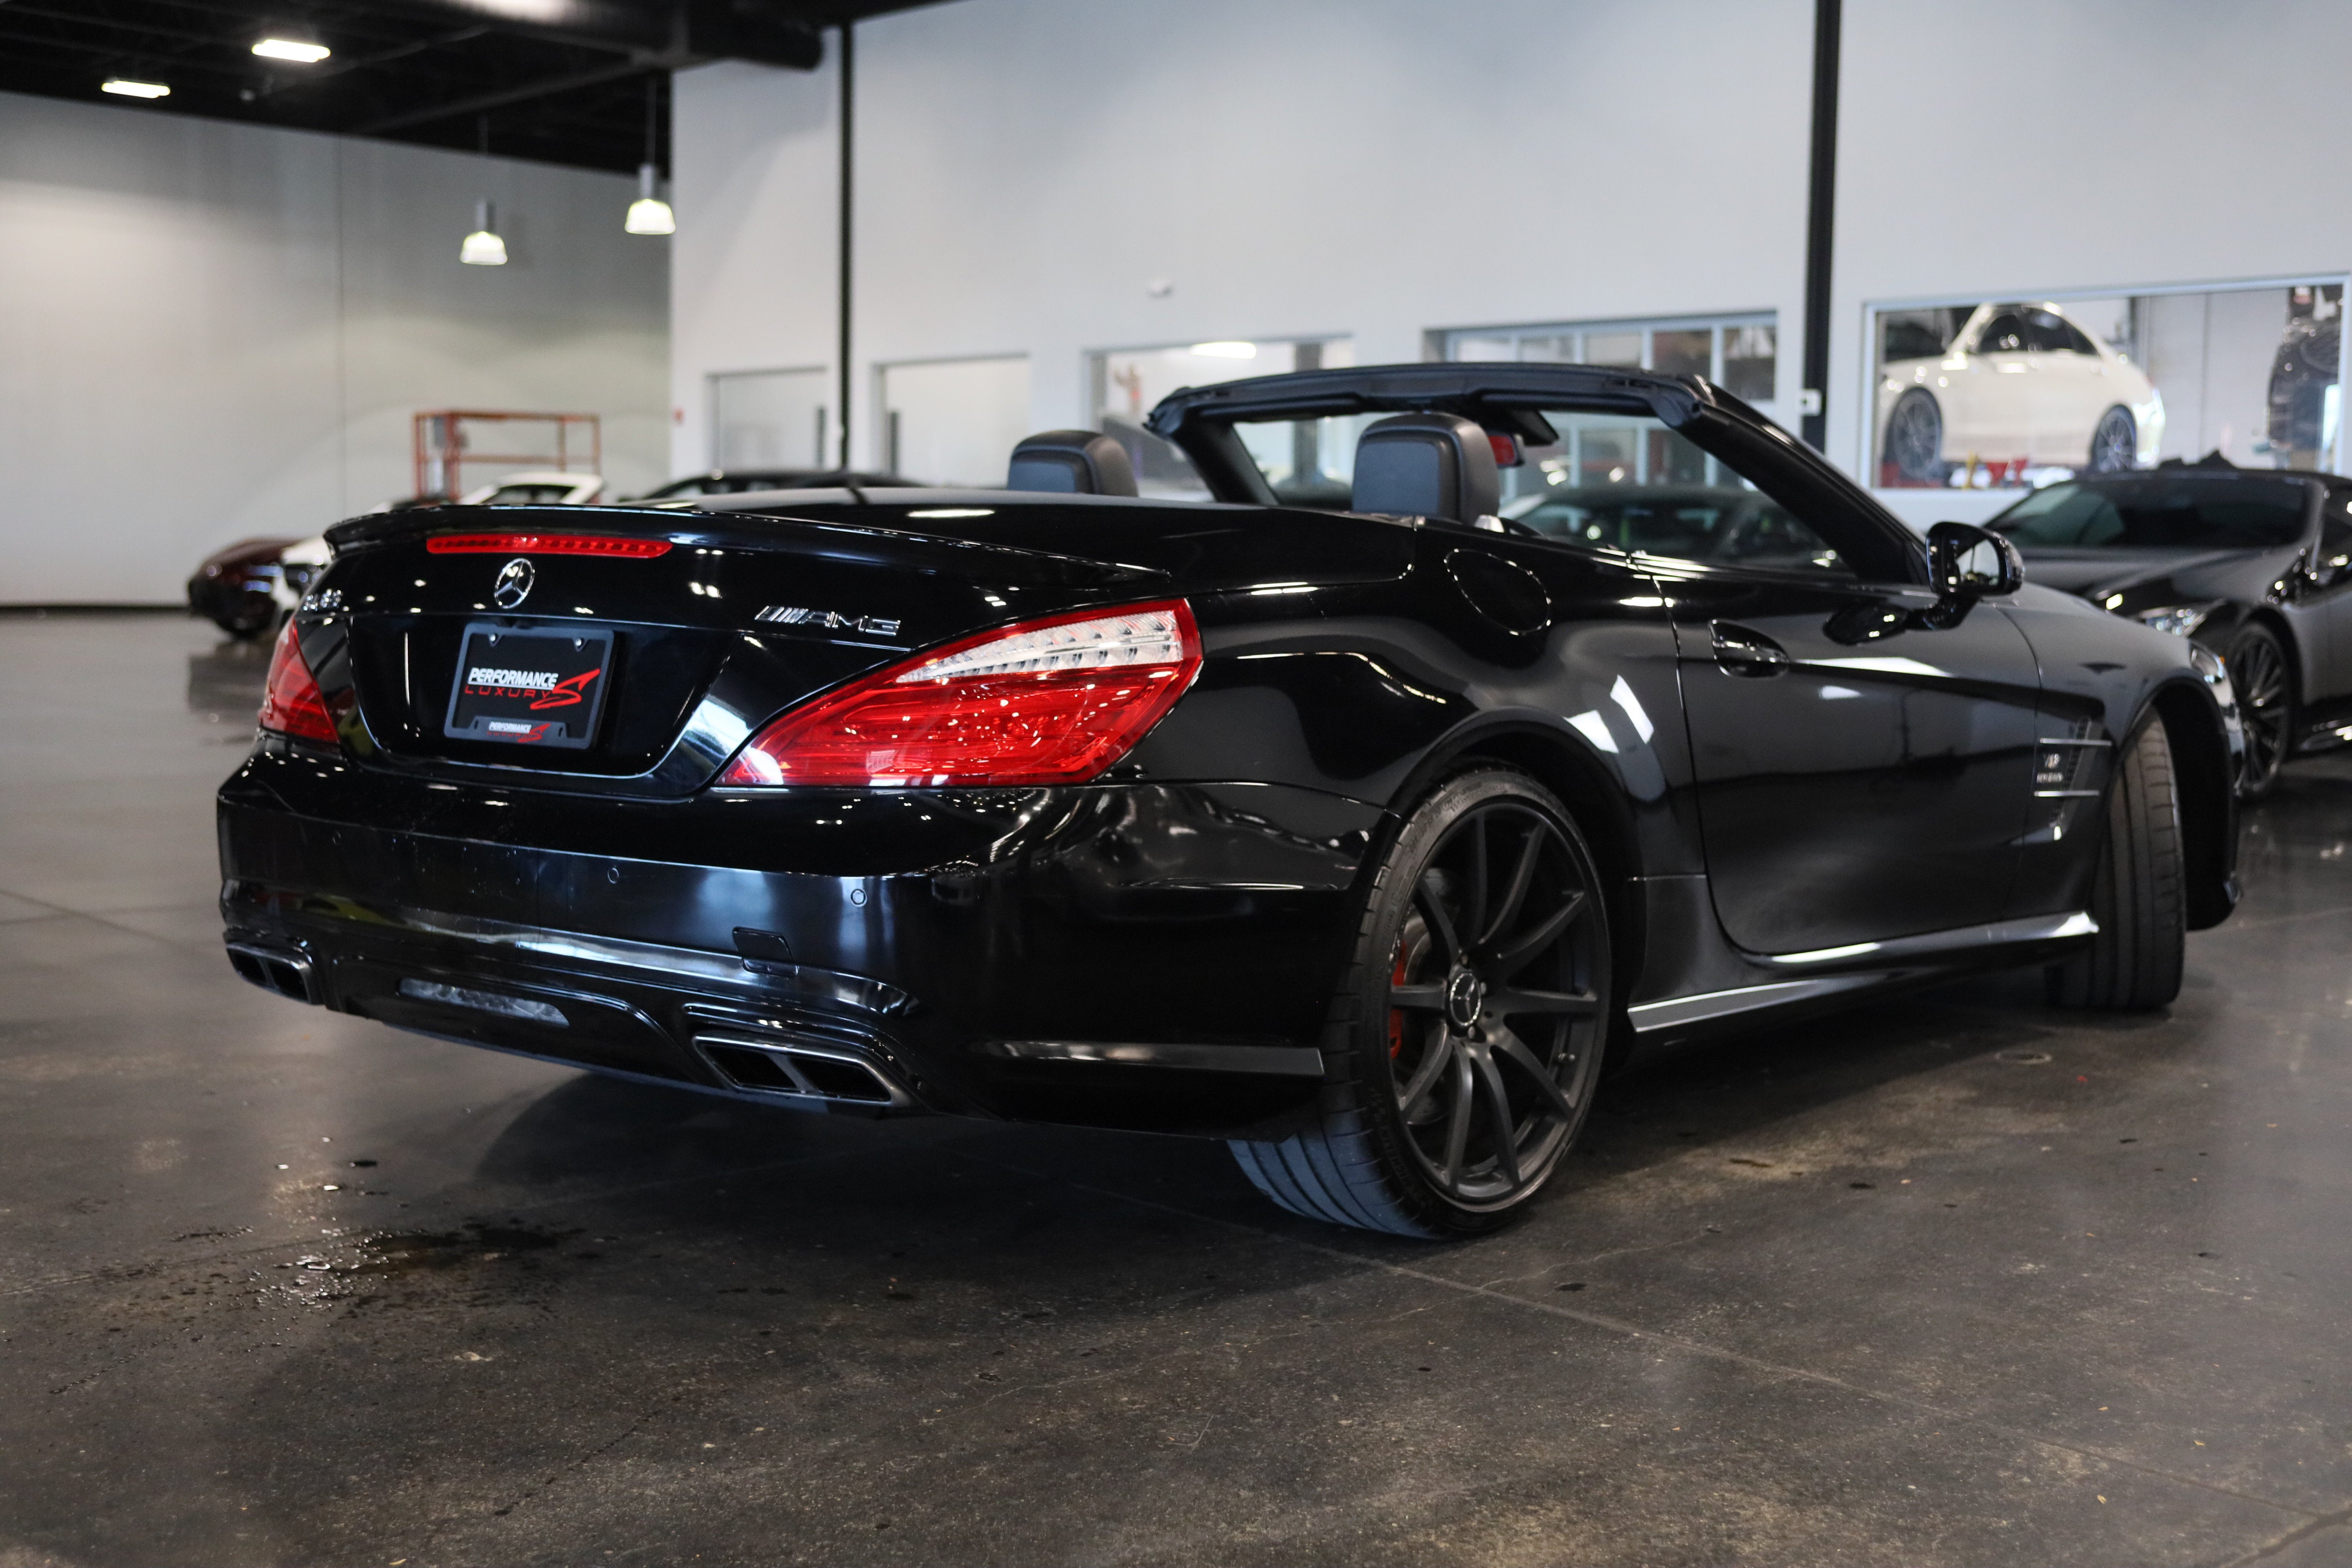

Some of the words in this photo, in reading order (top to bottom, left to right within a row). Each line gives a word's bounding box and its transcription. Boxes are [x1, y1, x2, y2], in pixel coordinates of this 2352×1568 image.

[468, 667, 559, 688] PERFORMANCE
[464, 684, 552, 699] LUXURY
[489, 721, 532, 733] PERFORMANCE
